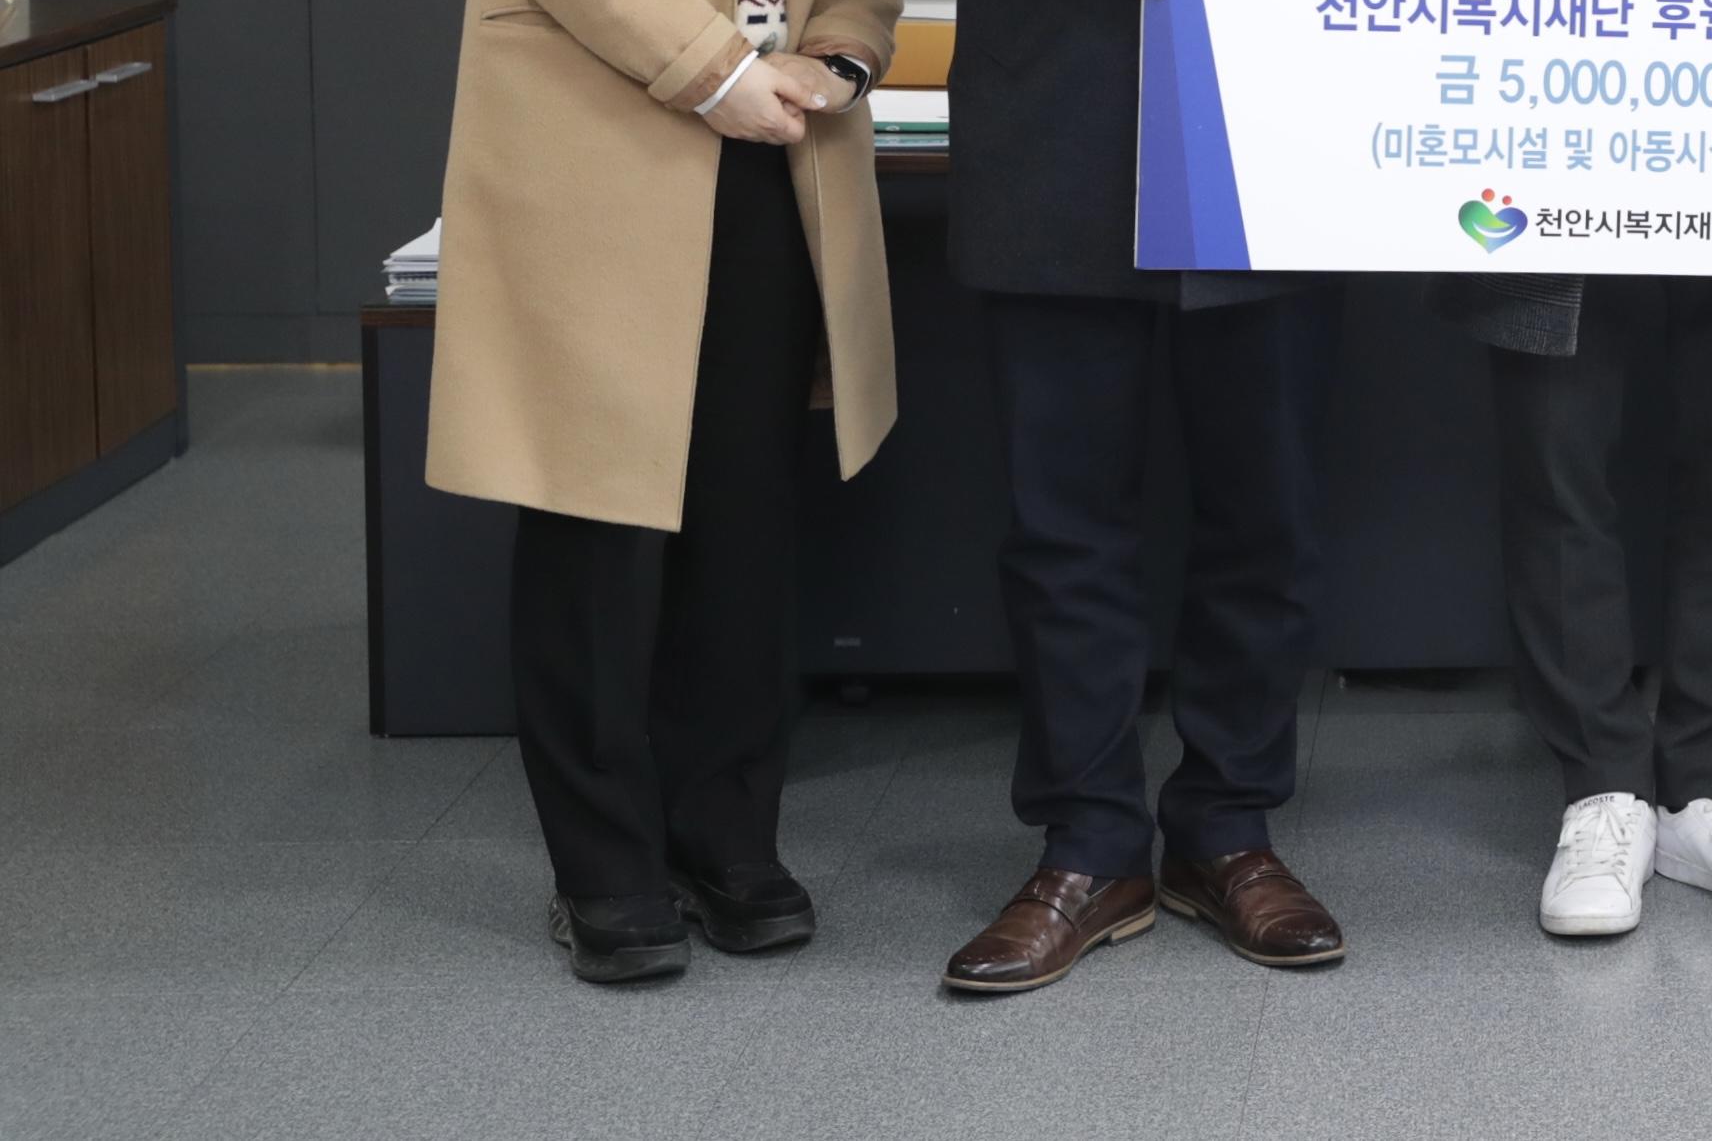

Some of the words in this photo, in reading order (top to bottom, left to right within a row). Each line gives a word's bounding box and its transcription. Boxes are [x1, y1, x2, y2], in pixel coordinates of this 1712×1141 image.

[1436, 55, 1480, 105] 금
[1372, 123, 1547, 170] (미혼모시설
[1565, 128, 1593, 170] 및
